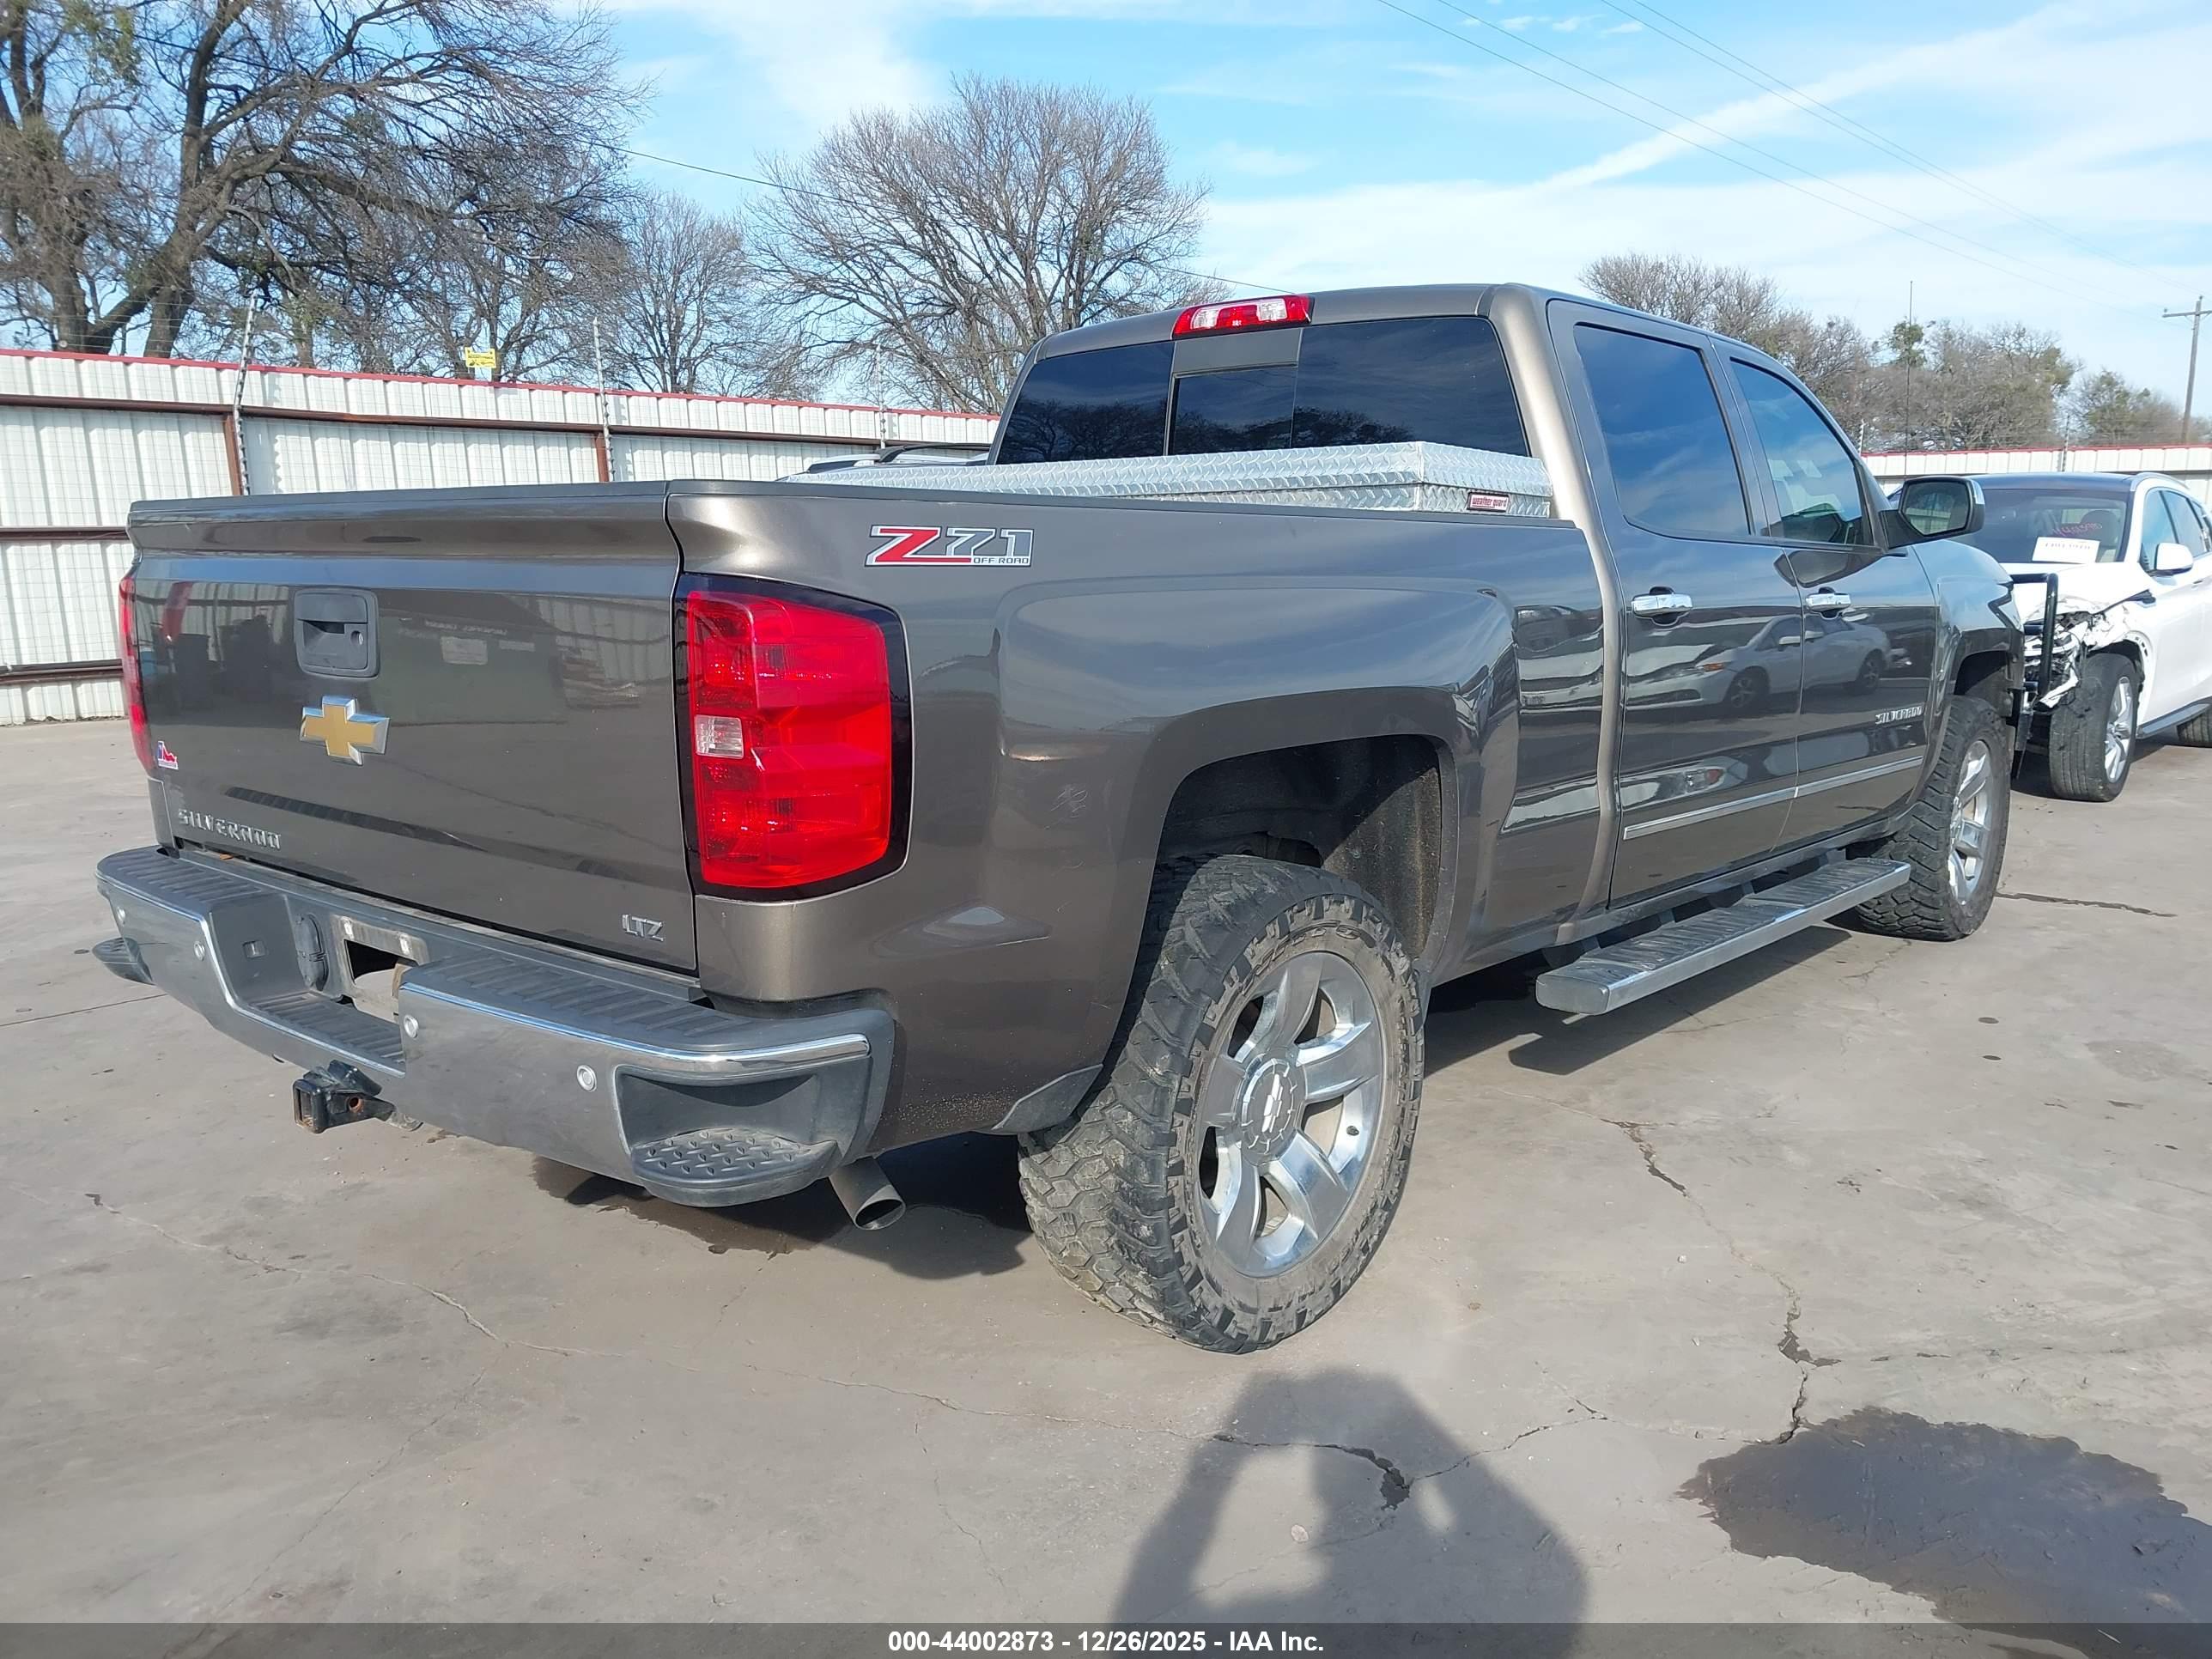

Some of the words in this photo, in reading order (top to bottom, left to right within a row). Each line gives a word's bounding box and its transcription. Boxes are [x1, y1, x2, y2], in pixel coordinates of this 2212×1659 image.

[864, 524, 1035, 568] Z71
[973, 556, 996, 565] OFF
[997, 556, 1030, 565] ROAD
[178, 808, 282, 850] SILVERADO
[622, 914, 665, 943] LTZ
